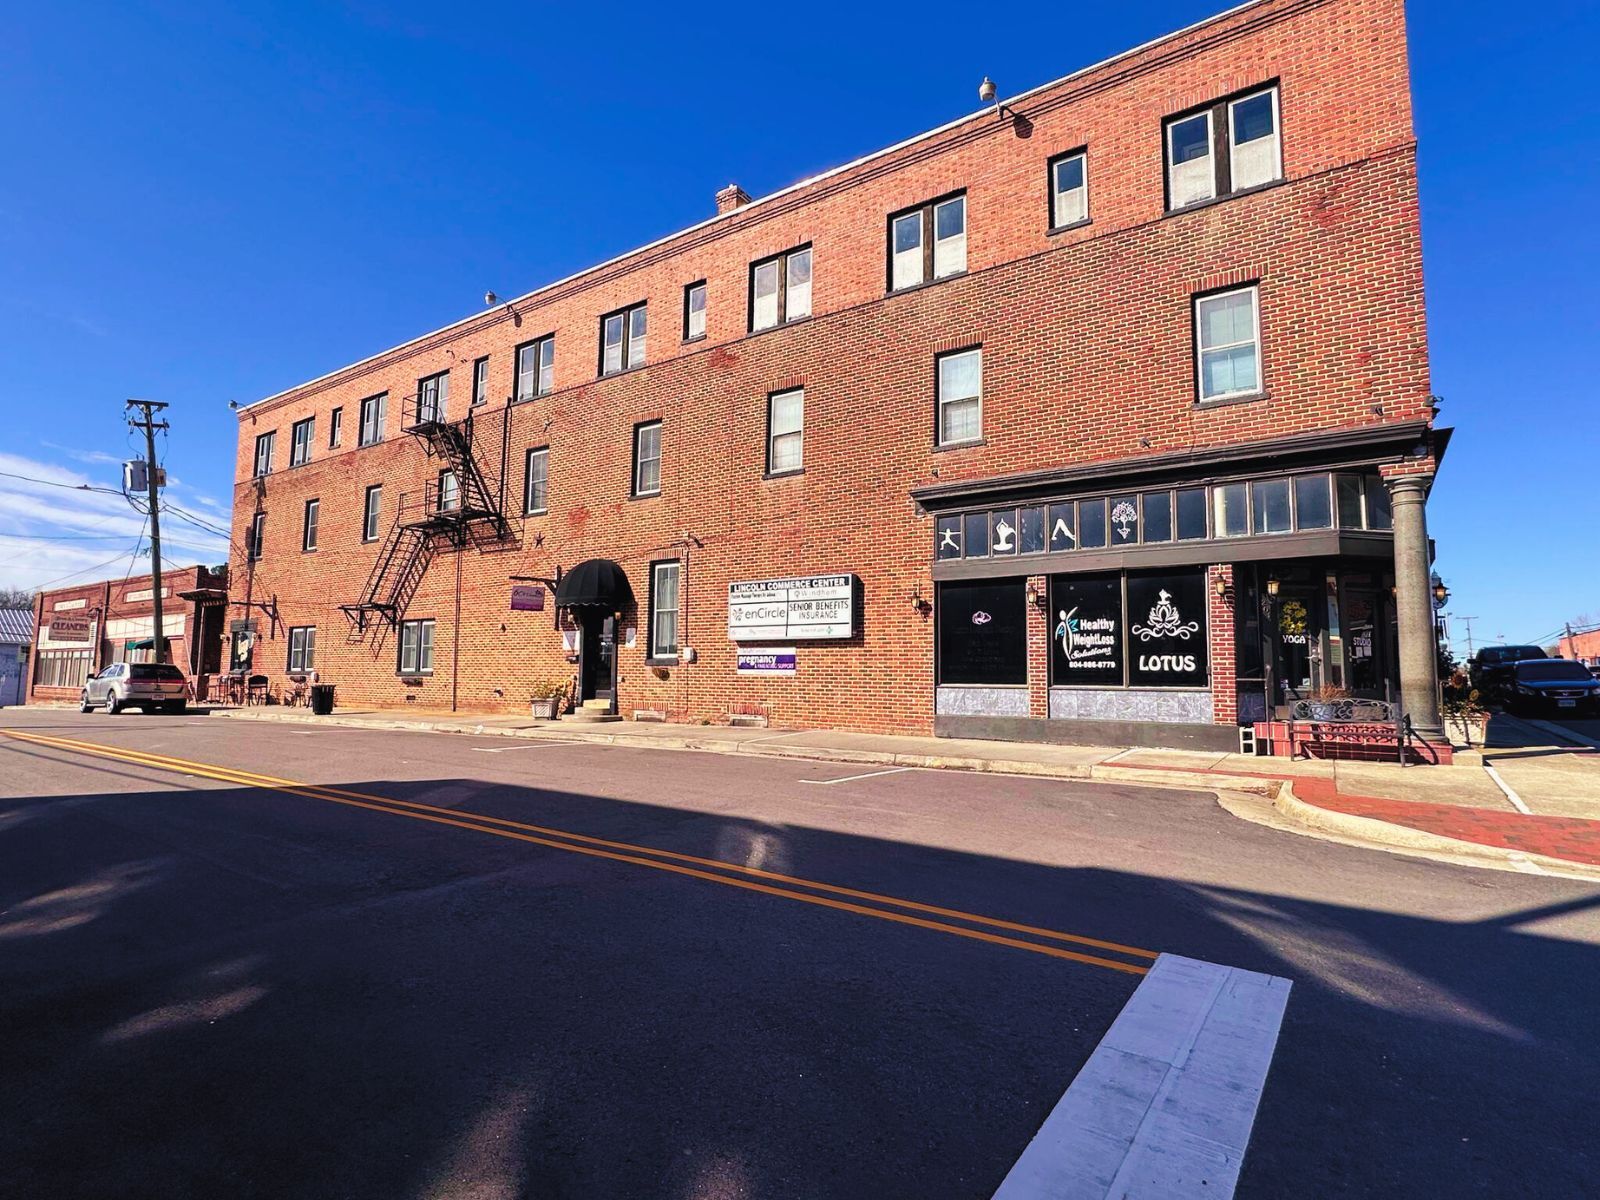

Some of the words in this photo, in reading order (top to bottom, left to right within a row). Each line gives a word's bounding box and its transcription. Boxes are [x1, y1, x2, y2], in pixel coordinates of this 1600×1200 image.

[734, 583, 766, 592] LINCOLN
[767, 579, 810, 590] COMMERCE
[812, 577, 845, 588] CENTER
[789, 602, 813, 612] SENIOR
[815, 600, 849, 610] BENEFITS
[745, 608, 786, 619] enCircle
[799, 610, 838, 620] INSURANCE
[52, 621, 89, 631] CLEANERS
[1080, 618, 1115, 632] Healthy
[1073, 633, 1115, 648] WeightLoss
[1282, 635, 1306, 644] YOGA
[1070, 647, 1112, 660] Solutions
[738, 655, 777, 666] pregnancy
[1139, 655, 1196, 672] LOTUS
